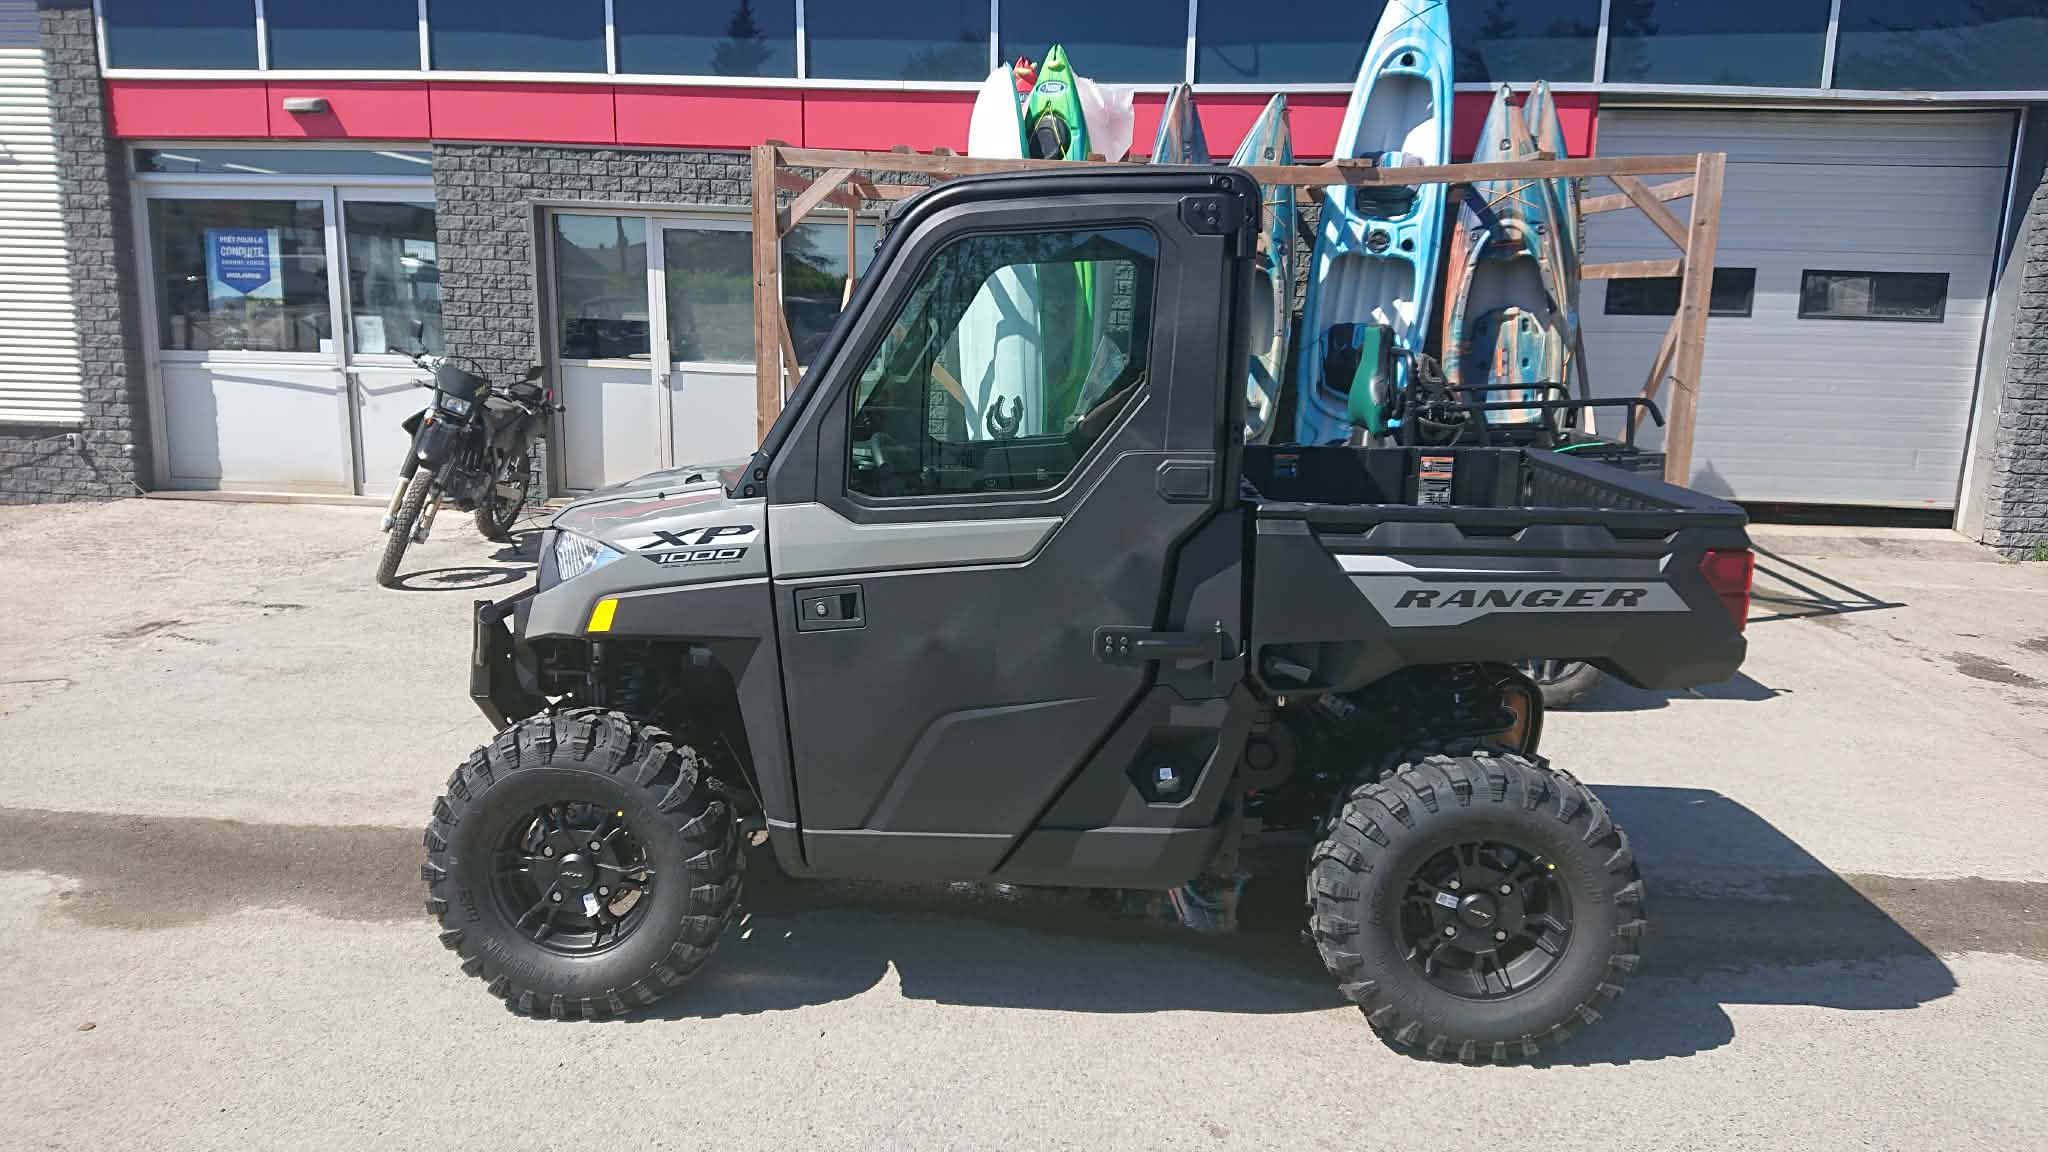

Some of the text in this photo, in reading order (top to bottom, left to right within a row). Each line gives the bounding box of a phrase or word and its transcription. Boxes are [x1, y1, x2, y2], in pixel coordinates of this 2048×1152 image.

[220, 246, 265, 257] CONDUITE
[638, 524, 756, 549] XP
[659, 549, 741, 563] 1000
[1394, 589, 1649, 609] RANGER
